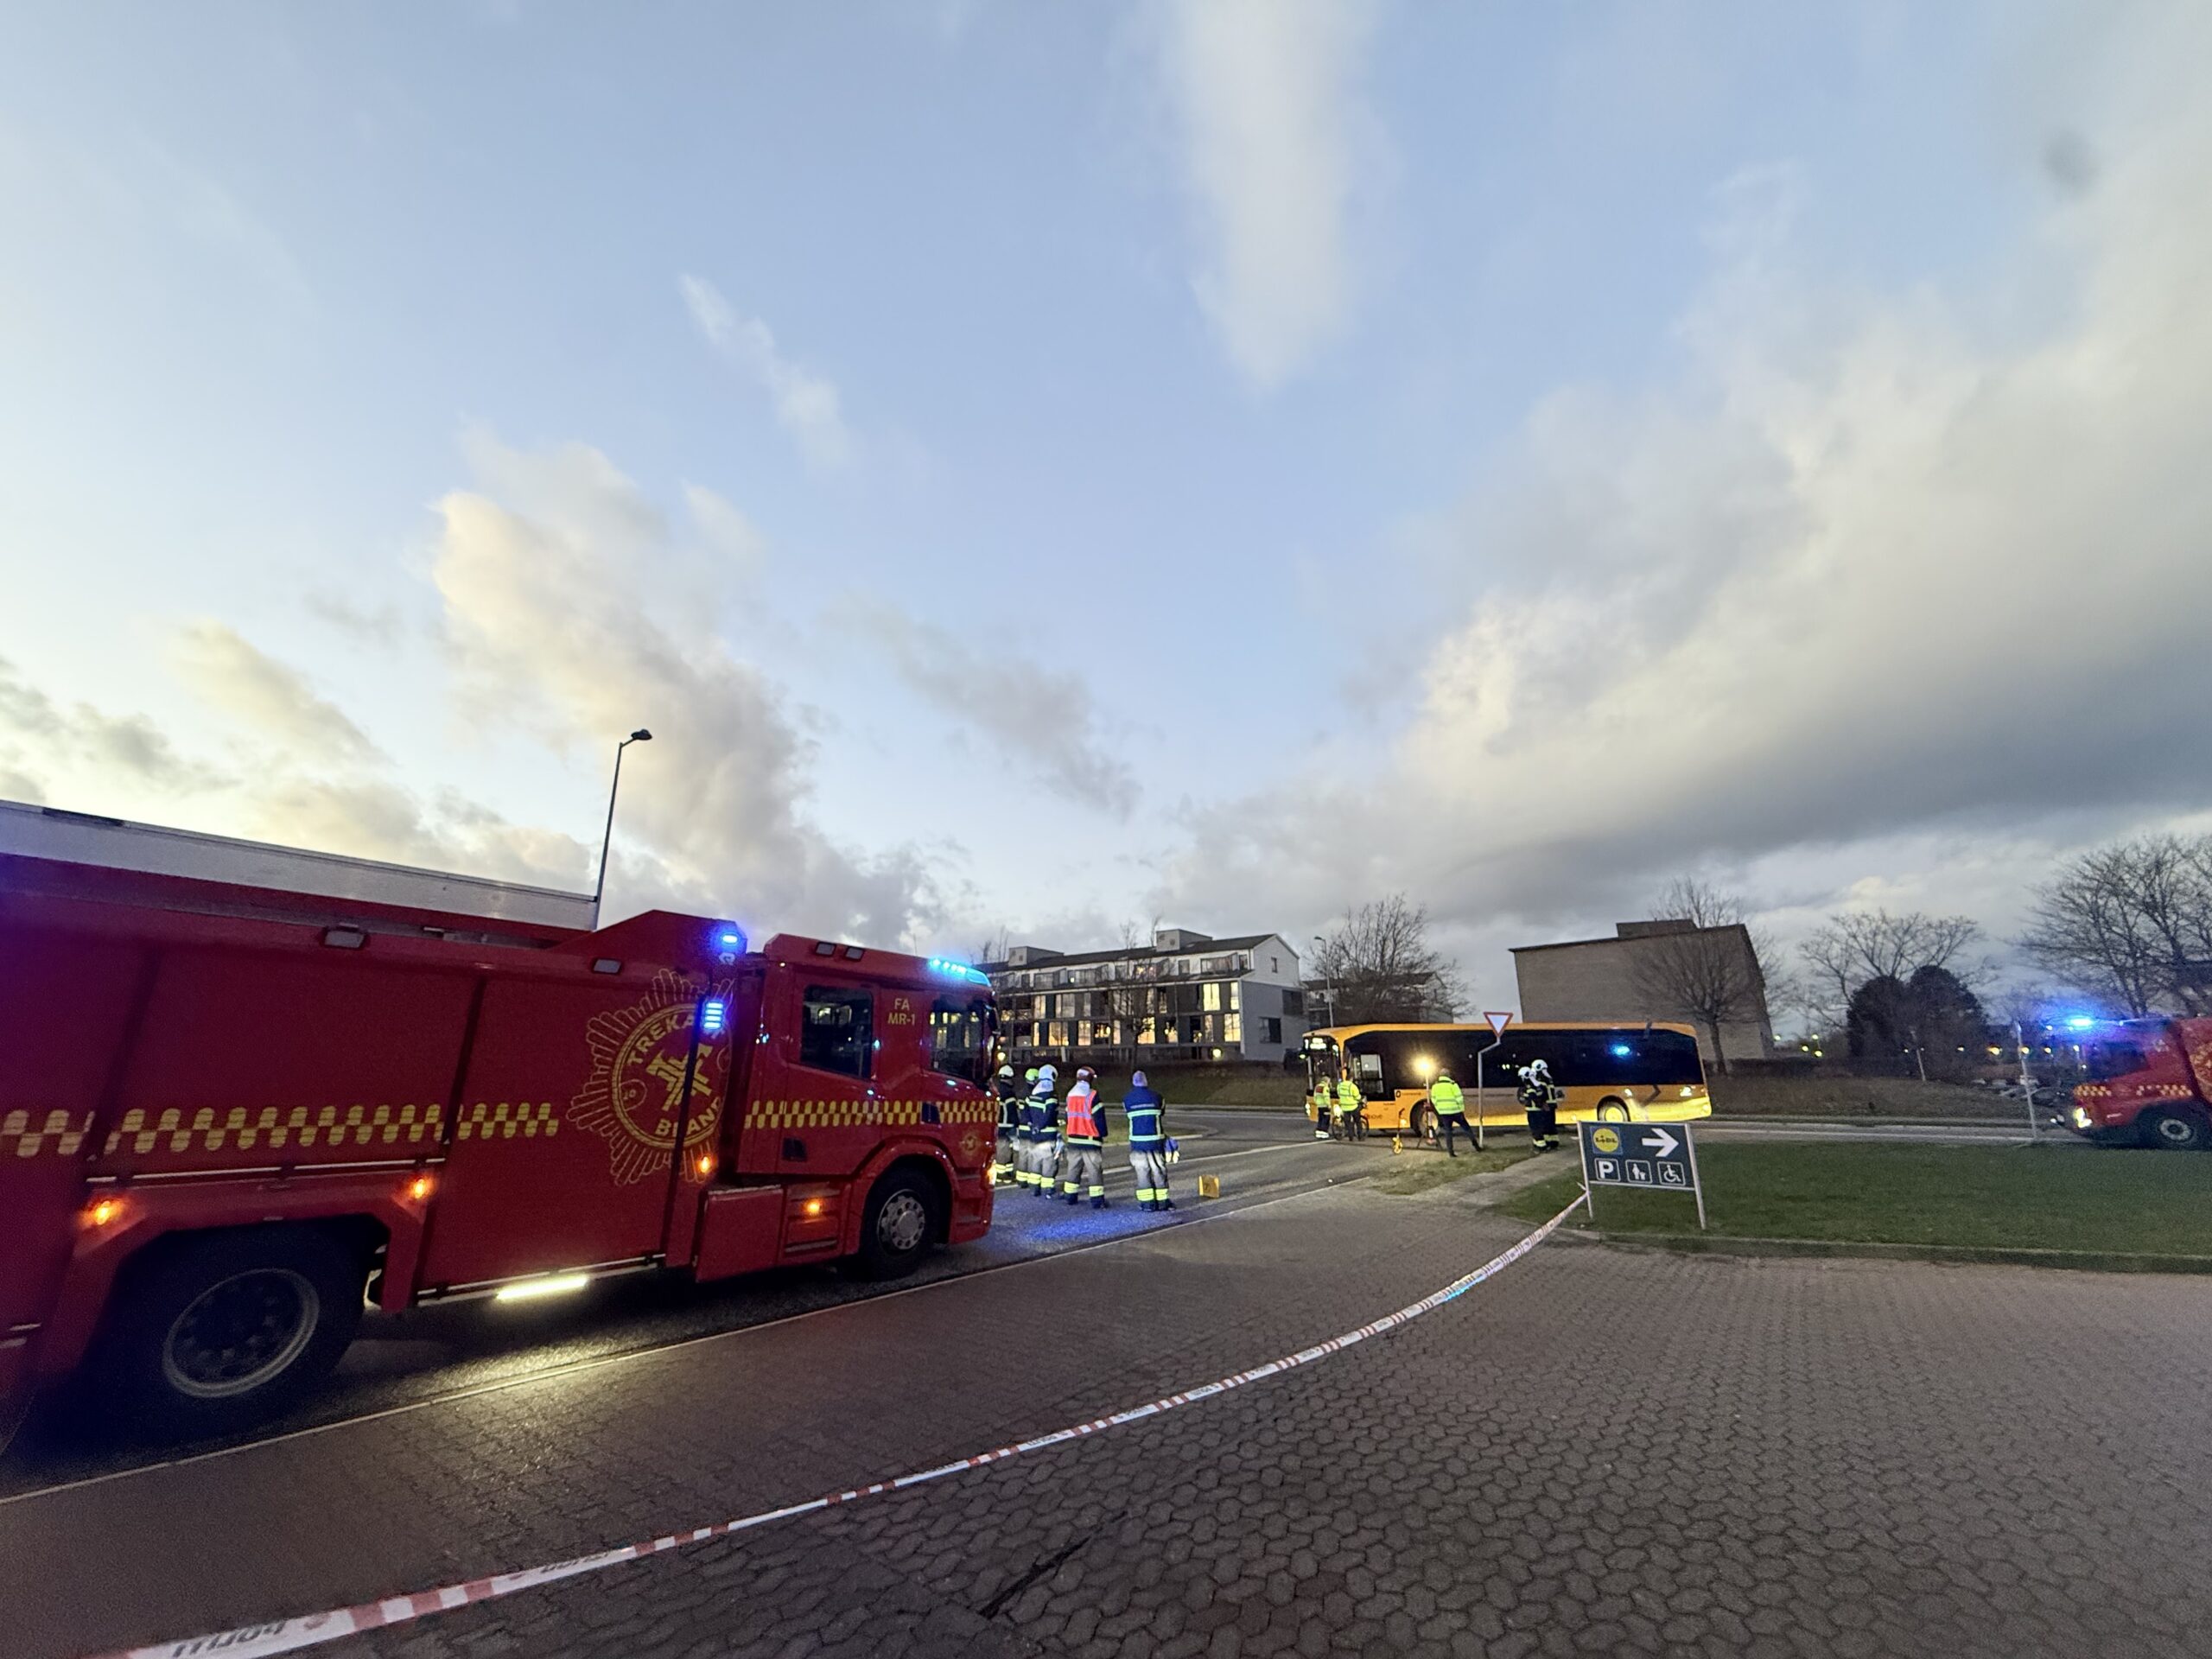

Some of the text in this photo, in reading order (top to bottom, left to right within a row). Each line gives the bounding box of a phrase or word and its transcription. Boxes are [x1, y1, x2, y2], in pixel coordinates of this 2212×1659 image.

[894, 997, 910, 1010] FA
[887, 1012, 916, 1026] MR-1
[626, 1013, 724, 1066] TREKA
[1599, 1160, 1614, 1179] P
